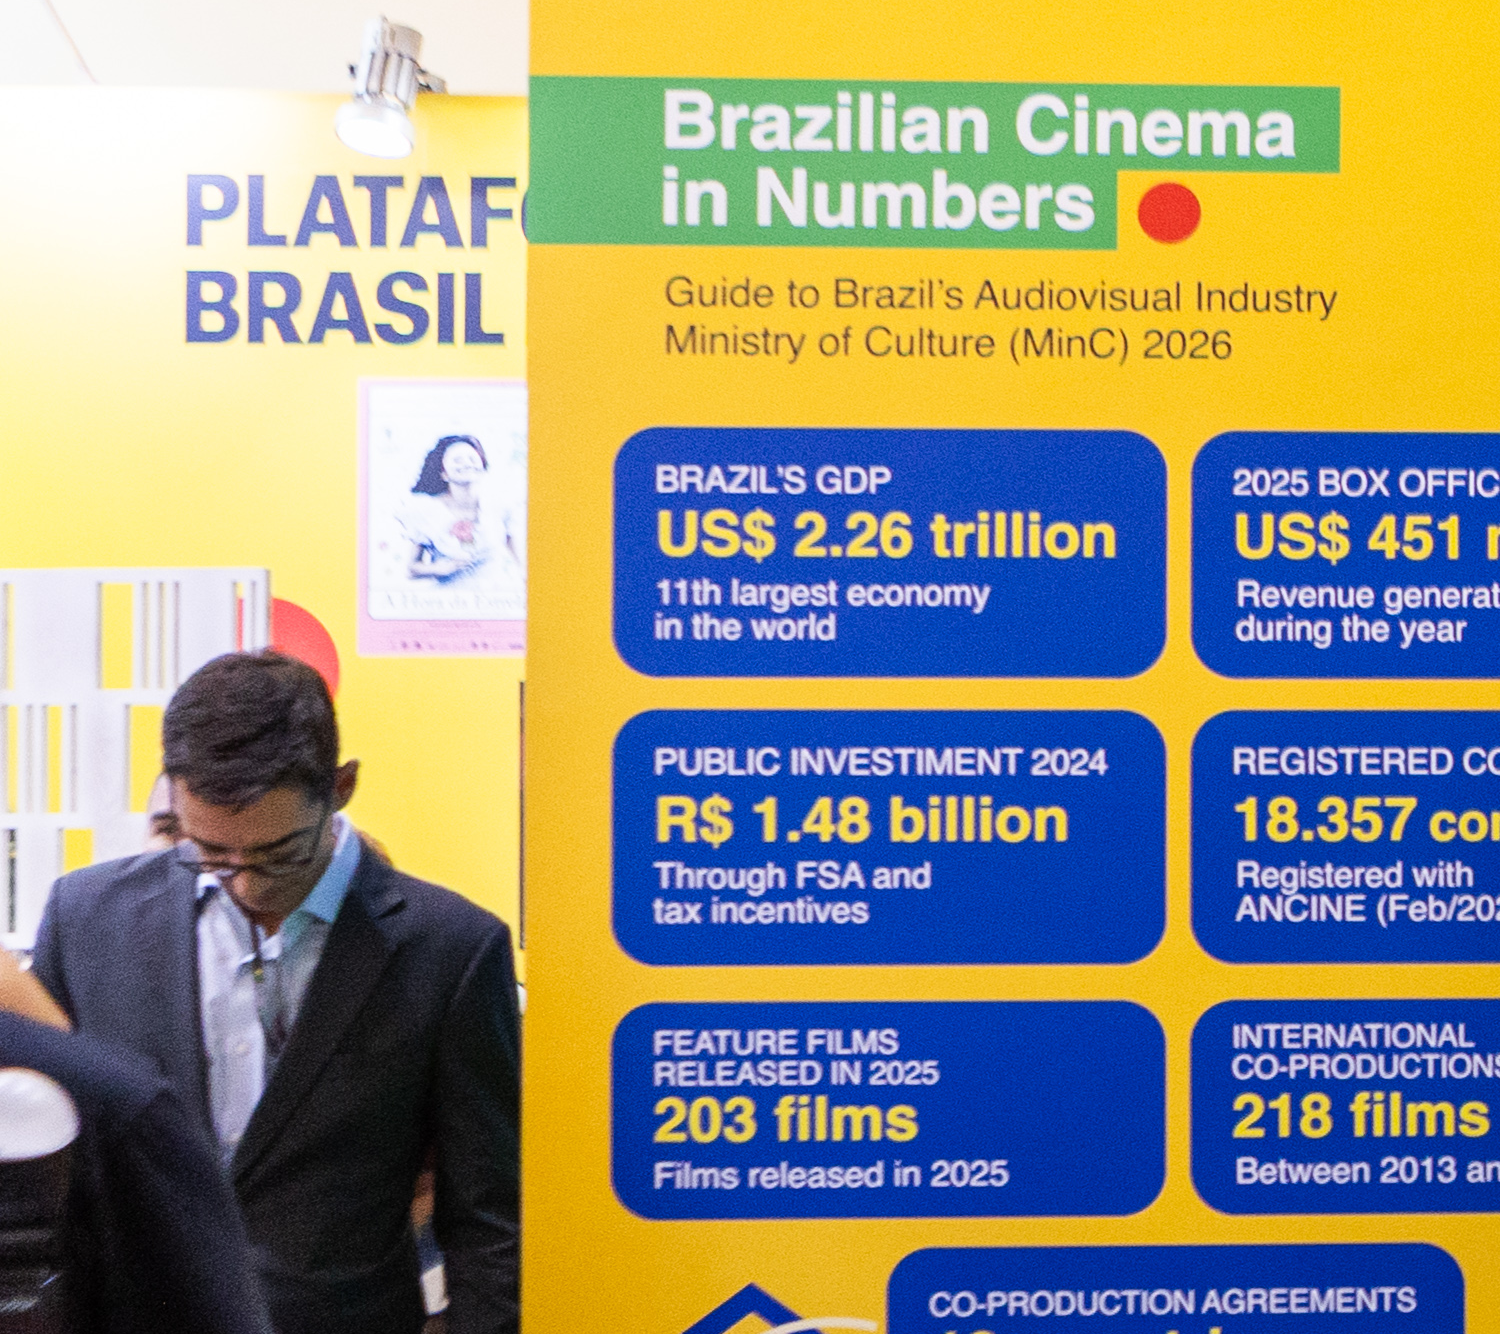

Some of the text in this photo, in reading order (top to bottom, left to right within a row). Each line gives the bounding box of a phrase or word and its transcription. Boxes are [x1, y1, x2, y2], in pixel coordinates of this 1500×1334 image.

[664, 88, 1296, 158] Brazilian Cinema
[185, 173, 530, 249] PLATAF
[662, 165, 1095, 231] in Numbers
[186, 270, 505, 346] BRASIL
[664, 274, 775, 309] Guide
[787, 279, 821, 309] to
[974, 278, 1181, 313] Audiovisual
[1196, 281, 1338, 322] Industry
[665, 323, 1233, 366] Ministry of Culture (MinC) 2026
[815, 464, 893, 495] GDP
[1232, 467, 1310, 497] 2025
[1318, 467, 1390, 498] BOX
[657, 507, 1116, 563] US$ 2.26 trillion
[1235, 510, 1351, 566] US$
[1367, 514, 1460, 561] 451
[656, 577, 991, 614] 11th largest economy
[1236, 578, 1376, 609] Revenue
[654, 611, 837, 641] in the world
[1234, 613, 1468, 650] during the year
[654, 746, 1109, 777] PUBLIC INVESTIMENT 2024
[1233, 746, 1455, 776] REGISTERED
[656, 793, 1068, 849] R$ 1.48 billion
[1234, 795, 1418, 843] 18.357
[652, 859, 932, 898] Through FSA and
[1236, 859, 1474, 896] Registered with
[652, 895, 870, 925] tax incentives
[1235, 893, 1367, 923] ANCINE
[653, 1028, 900, 1056] FEATURE FILMS
[1232, 1021, 1476, 1049] INTERNATIONAL
[653, 1059, 940, 1087] RELEASED IN 2025
[653, 1094, 919, 1144] 203 films
[1232, 1090, 1491, 1139] 218 films
[653, 1159, 1010, 1190] Films released in 2025
[1235, 1155, 1371, 1185] Between
[1379, 1155, 1458, 1184] 2013
[928, 1285, 1418, 1318] CO-PRODUCTION AGREEMENTS
